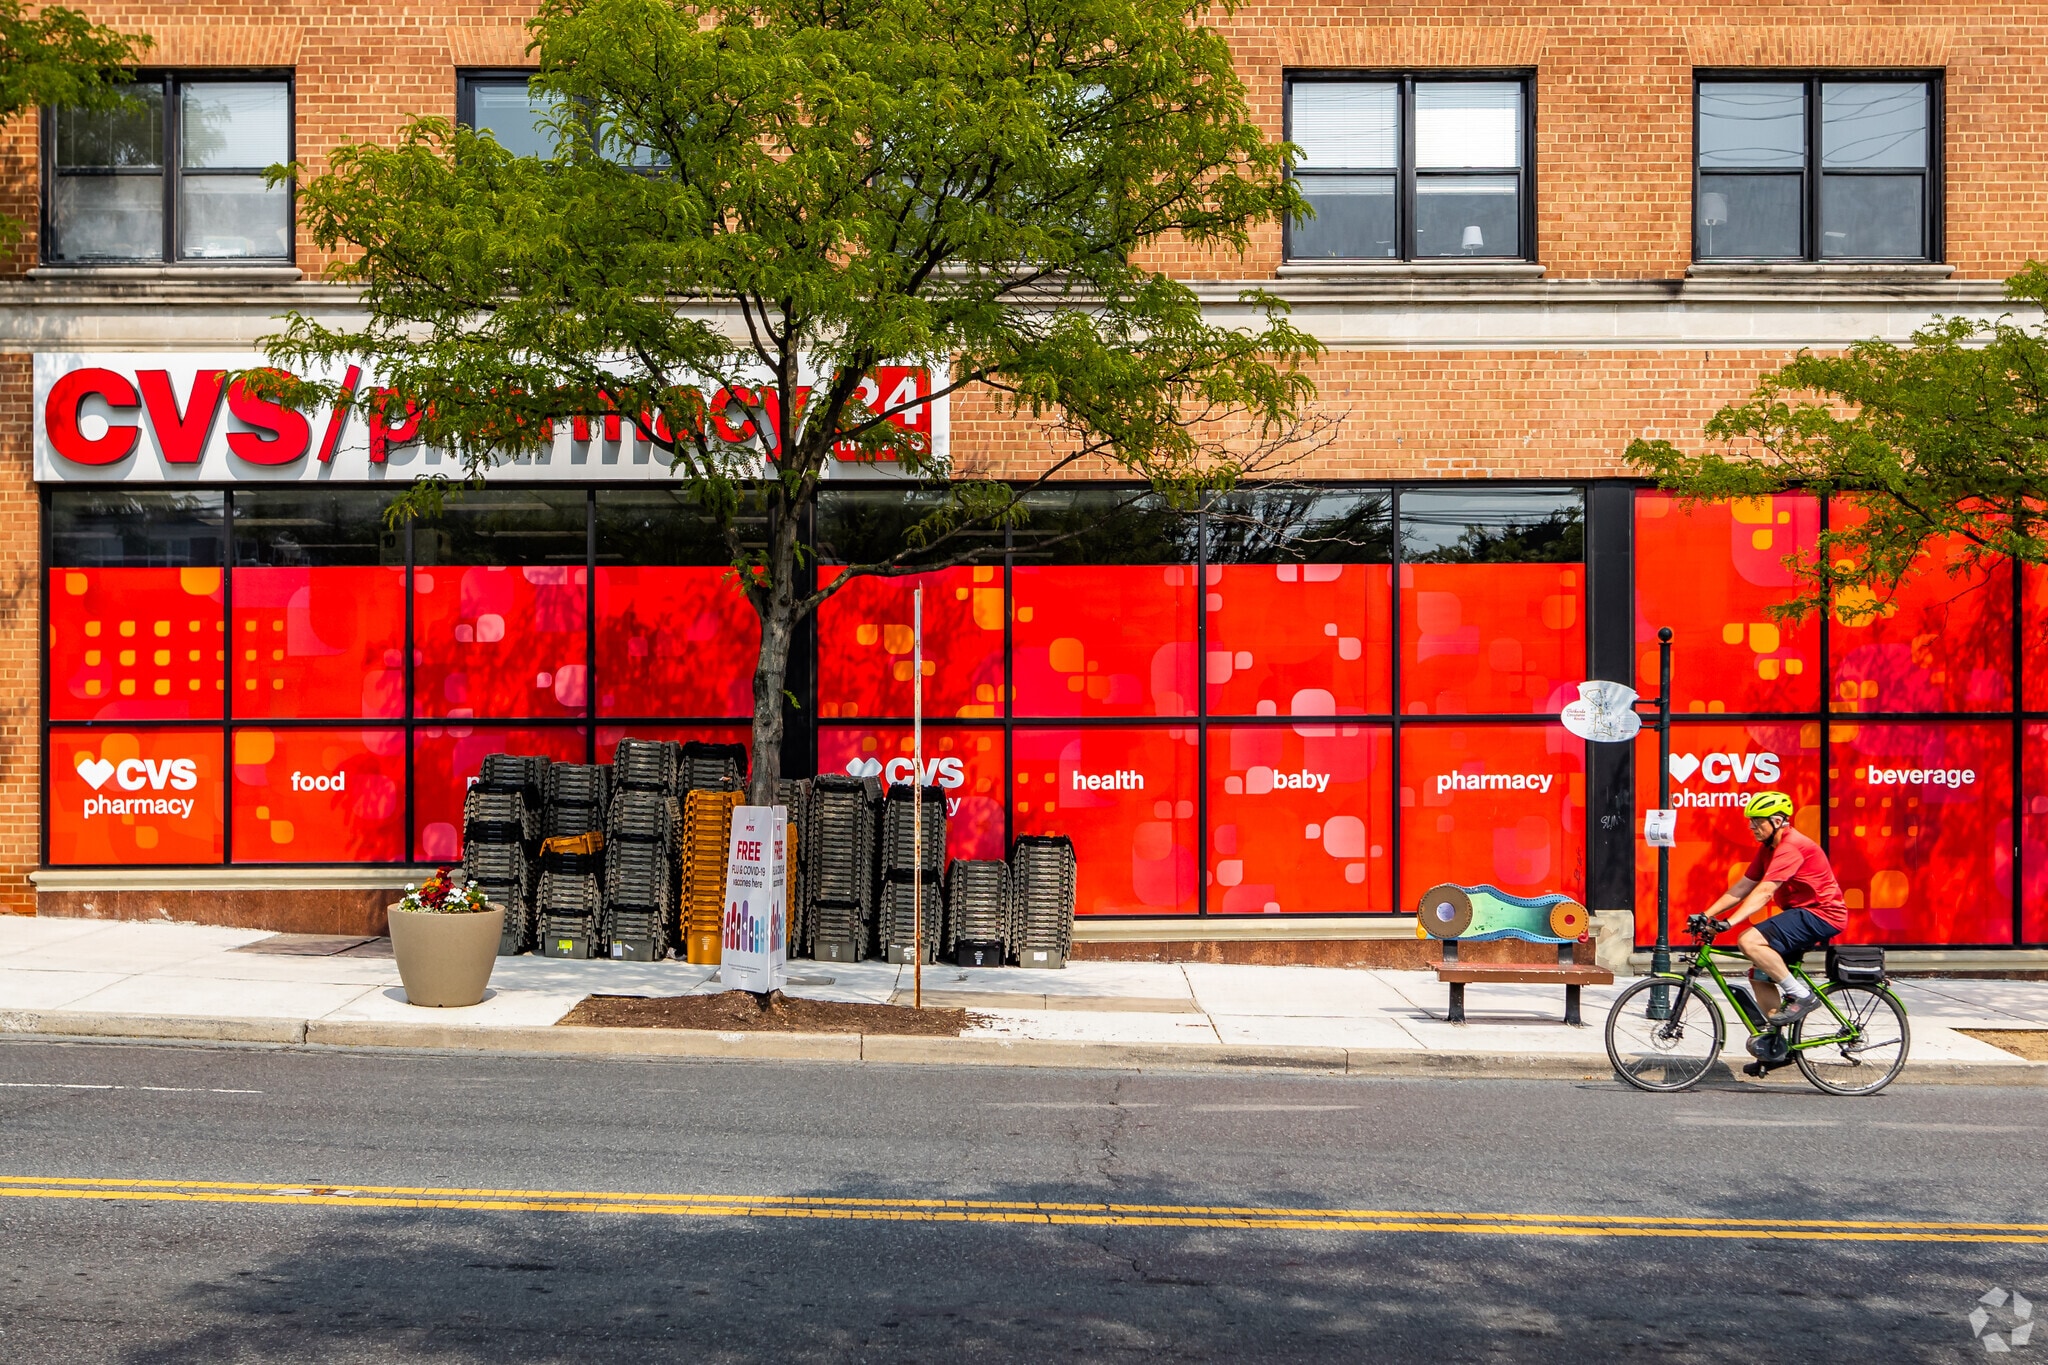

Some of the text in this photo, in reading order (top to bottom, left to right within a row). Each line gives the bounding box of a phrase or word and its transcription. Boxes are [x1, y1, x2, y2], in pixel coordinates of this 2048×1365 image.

[849, 375, 923, 425] 24
[117, 758, 198, 791] CVS
[885, 757, 965, 789] CVS
[1701, 752, 1781, 784] CVS
[1868, 765, 1976, 788] beverage
[291, 771, 345, 791] food
[1072, 770, 1144, 791] health
[1273, 770, 1330, 793] baby
[1437, 771, 1553, 793] pharmacy
[83, 794, 195, 819] pharmacy
[1672, 788, 1757, 808] pharma
[733, 878, 751, 887] vaccines
[752, 878, 763, 888] here
[743, 866, 766, 877] COVID-19
